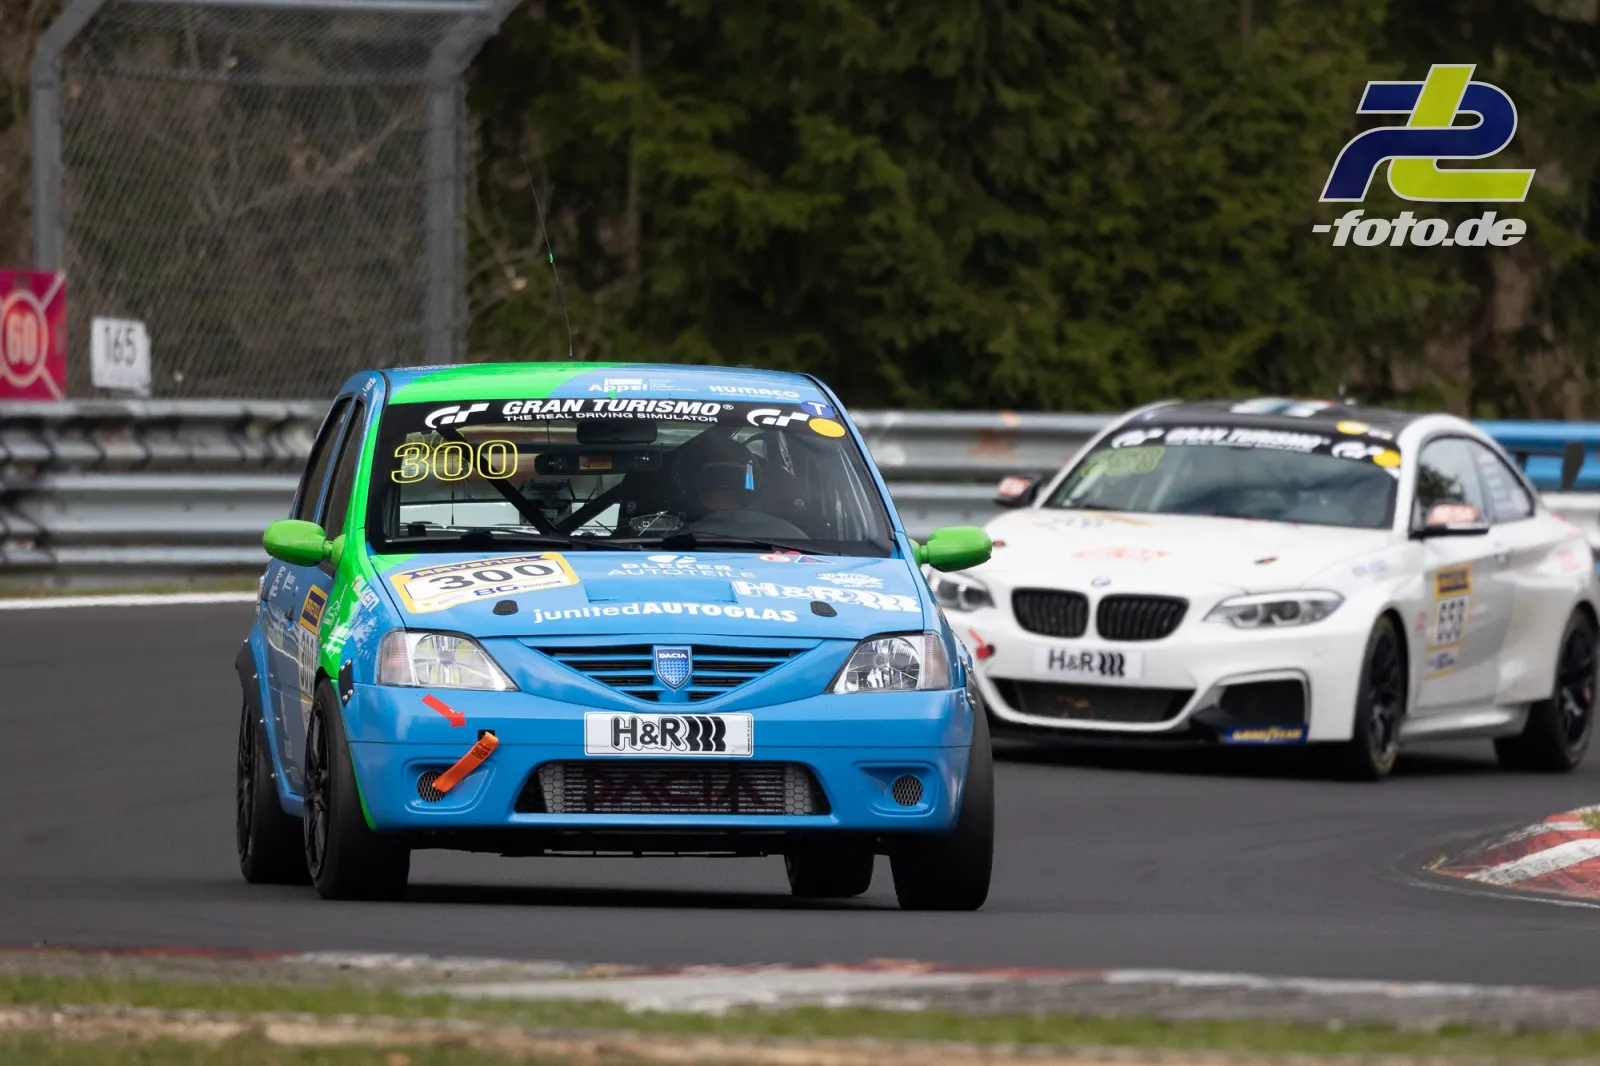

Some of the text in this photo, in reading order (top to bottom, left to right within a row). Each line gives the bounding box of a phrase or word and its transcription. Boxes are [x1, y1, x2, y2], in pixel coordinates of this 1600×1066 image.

[104, 325, 137, 367] 165
[502, 400, 580, 416] GRAN
[638, 413, 719, 423] SIMULATOR
[391, 439, 519, 484] 300
[429, 564, 556, 590] 300
[608, 568, 757, 579] AUTOTEILE
[658, 652, 687, 660] DACIA
[611, 714, 690, 751] H&R
